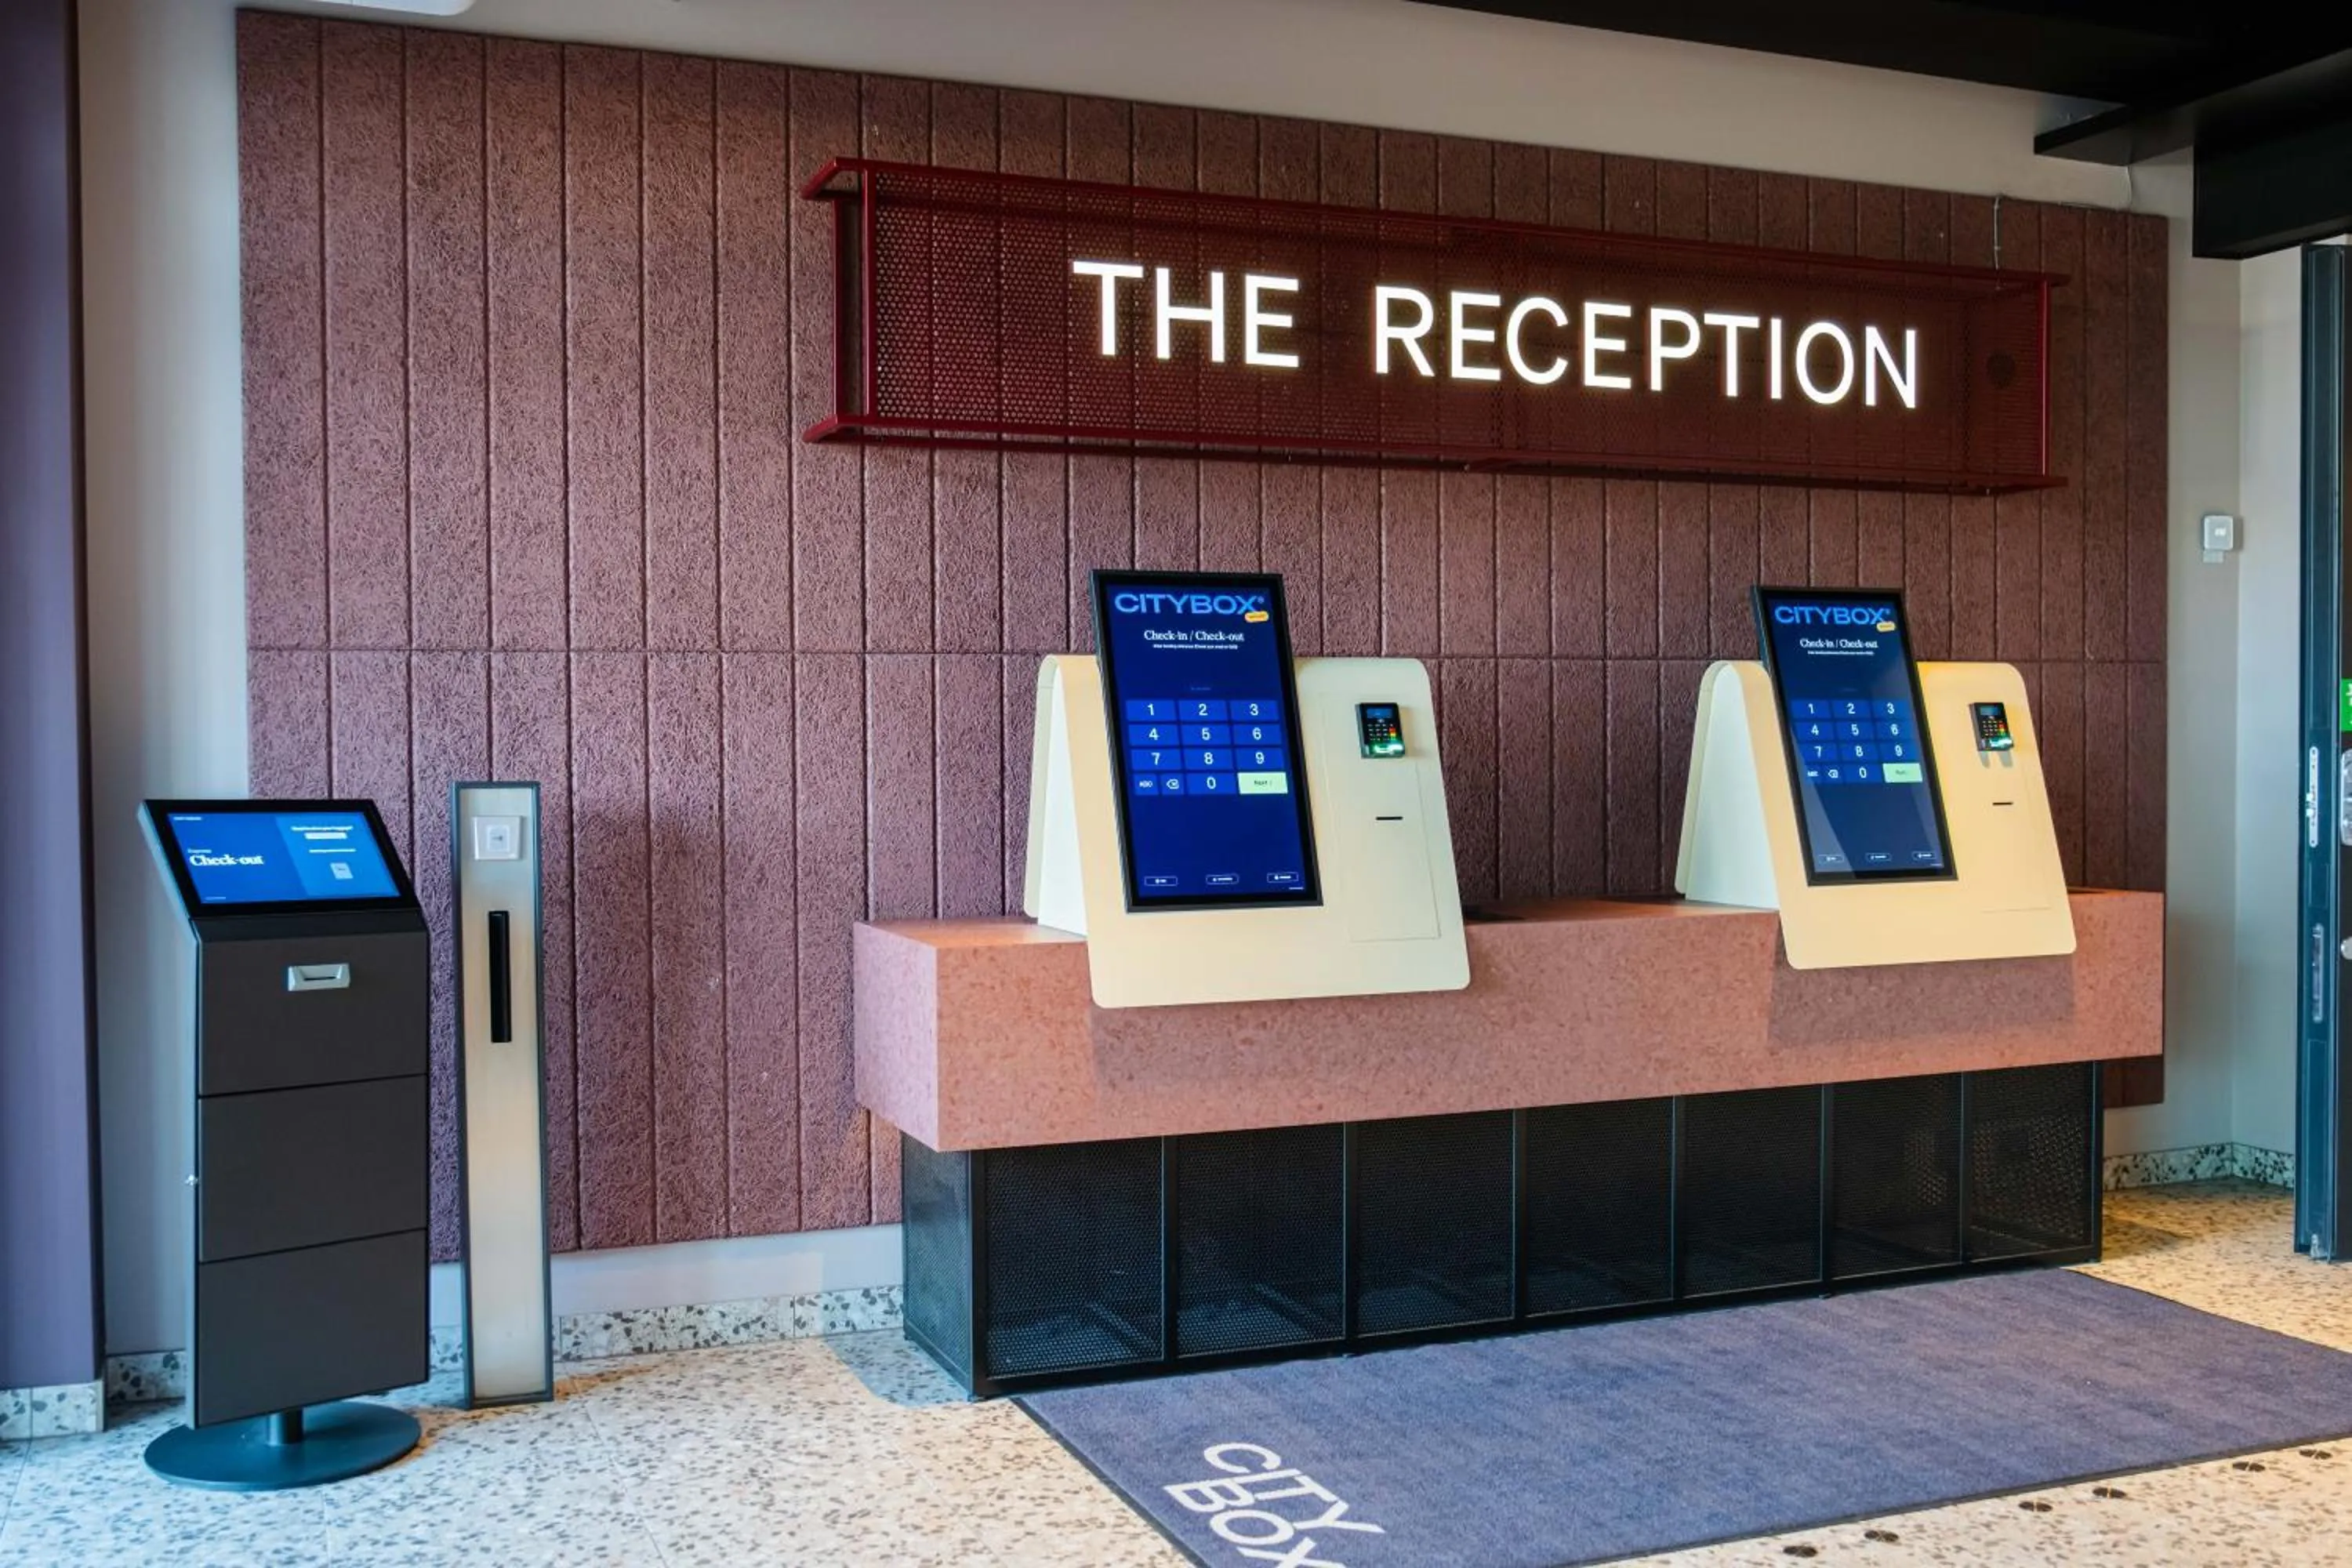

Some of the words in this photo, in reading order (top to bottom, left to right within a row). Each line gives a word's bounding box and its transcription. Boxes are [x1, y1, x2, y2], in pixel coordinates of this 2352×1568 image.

[1073, 260, 1300, 368] THE
[1374, 285, 1917, 409] RECEPTION
[1144, 630, 1188, 641] Check-in
[1195, 630, 1244, 642] Check-out
[1147, 703, 1154, 716] 1
[1199, 703, 1208, 716] 2
[1250, 703, 1259, 716] 3
[1808, 703, 1814, 714] 1
[1847, 702, 1856, 714] 2
[1886, 702, 1895, 714] 3
[1149, 728, 1160, 740] 4
[1202, 728, 1210, 740] 5
[1252, 728, 1261, 740] 6
[1811, 724, 1819, 735] 4
[1851, 724, 1859, 735] 5
[1890, 724, 1900, 735] 6
[1814, 746, 1822, 757] 7
[1855, 746, 1864, 757] 8
[1894, 745, 1903, 757] 9
[1151, 753, 1160, 765] 7
[1204, 752, 1214, 765] 8
[1255, 752, 1265, 764] 9
[1859, 767, 1867, 779] 0
[1207, 776, 1216, 789] 0
[190, 854, 264, 866] Check-out
[1203, 1442, 1386, 1534] CITY
[1163, 1479, 1347, 1568] BOX
